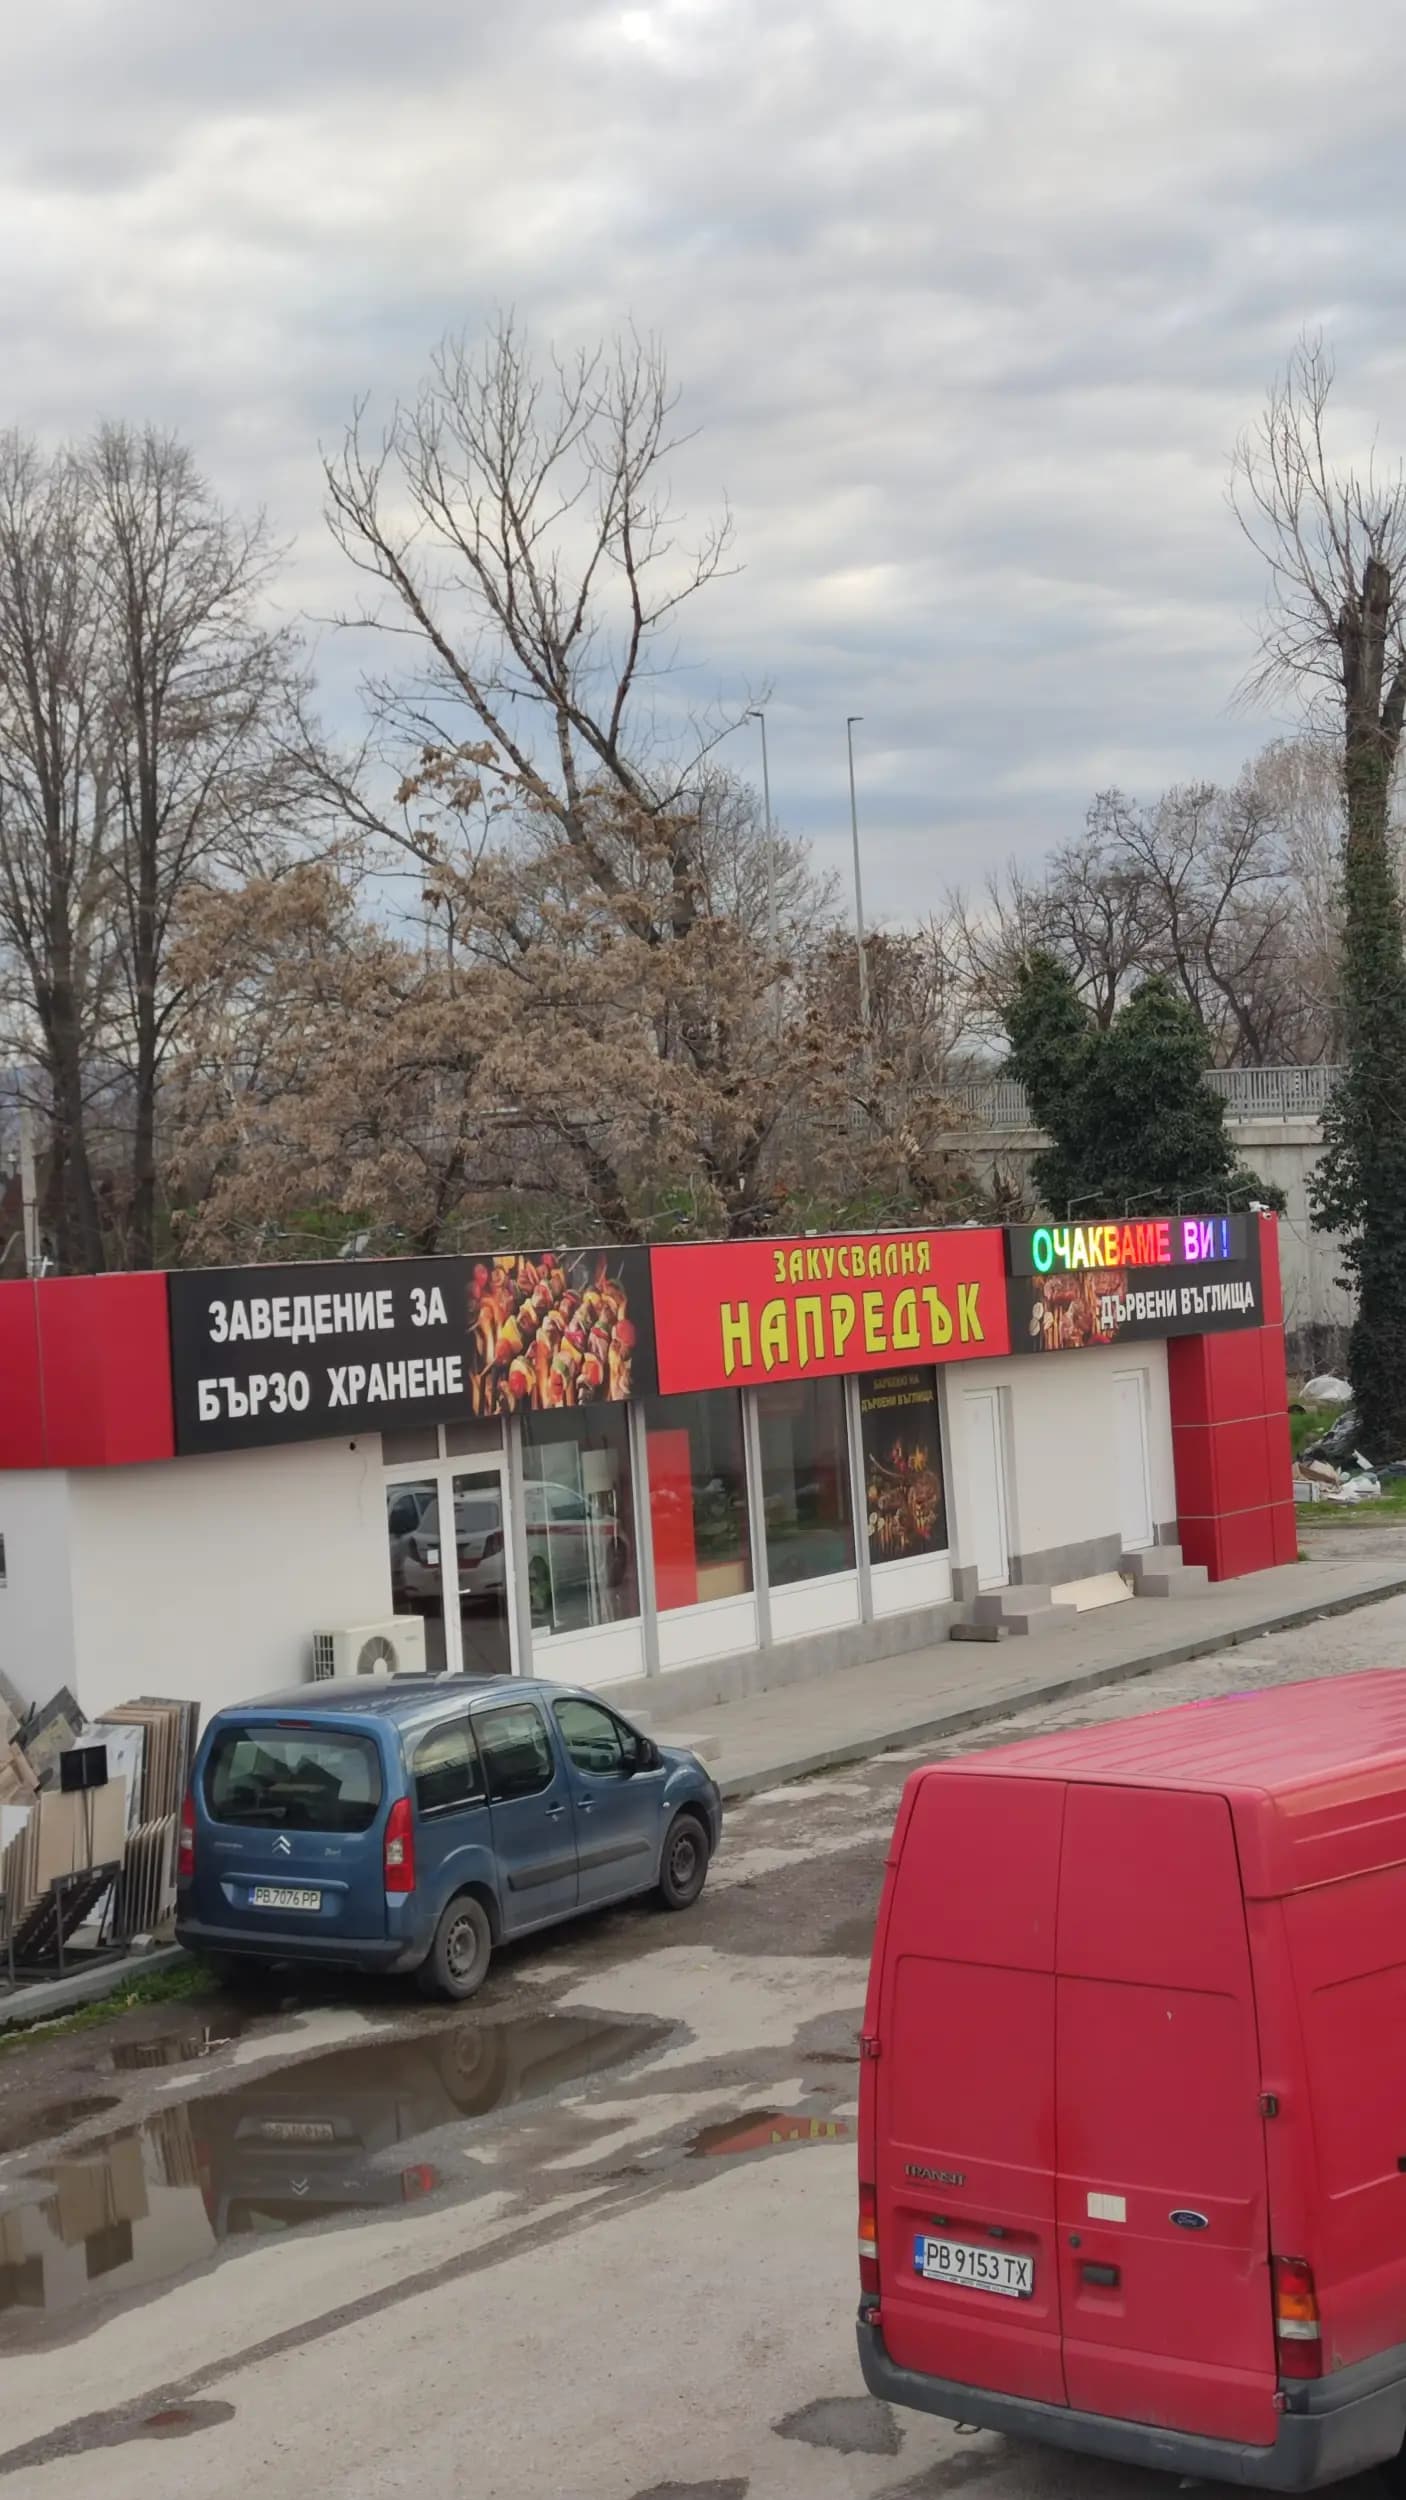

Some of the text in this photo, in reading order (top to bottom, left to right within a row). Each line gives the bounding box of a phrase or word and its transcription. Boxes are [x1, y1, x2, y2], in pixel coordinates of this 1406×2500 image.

[773, 1241, 931, 1284] ЗАКУСВАЛНЯ
[1032, 1223, 1171, 1272] ОЧАКВАМЕ
[208, 1286, 448, 1344] ЗАВЕДЕНИЕ ЗА
[720, 1282, 985, 1377] НАПРЕДЪК
[1100, 1281, 1255, 1330] ДЪРВЕНИ ВЪГЛИЩА
[197, 1355, 464, 1422] БЪРЗО ХРАНЕНЕ
[273, 1889, 299, 1906] 7076
[302, 1892, 318, 1907] PP
[905, 2163, 966, 2186] TRANSIT
[927, 2243, 950, 2270] PB
[955, 2249, 999, 2280] 9153
[1004, 2258, 1028, 2287] TX
